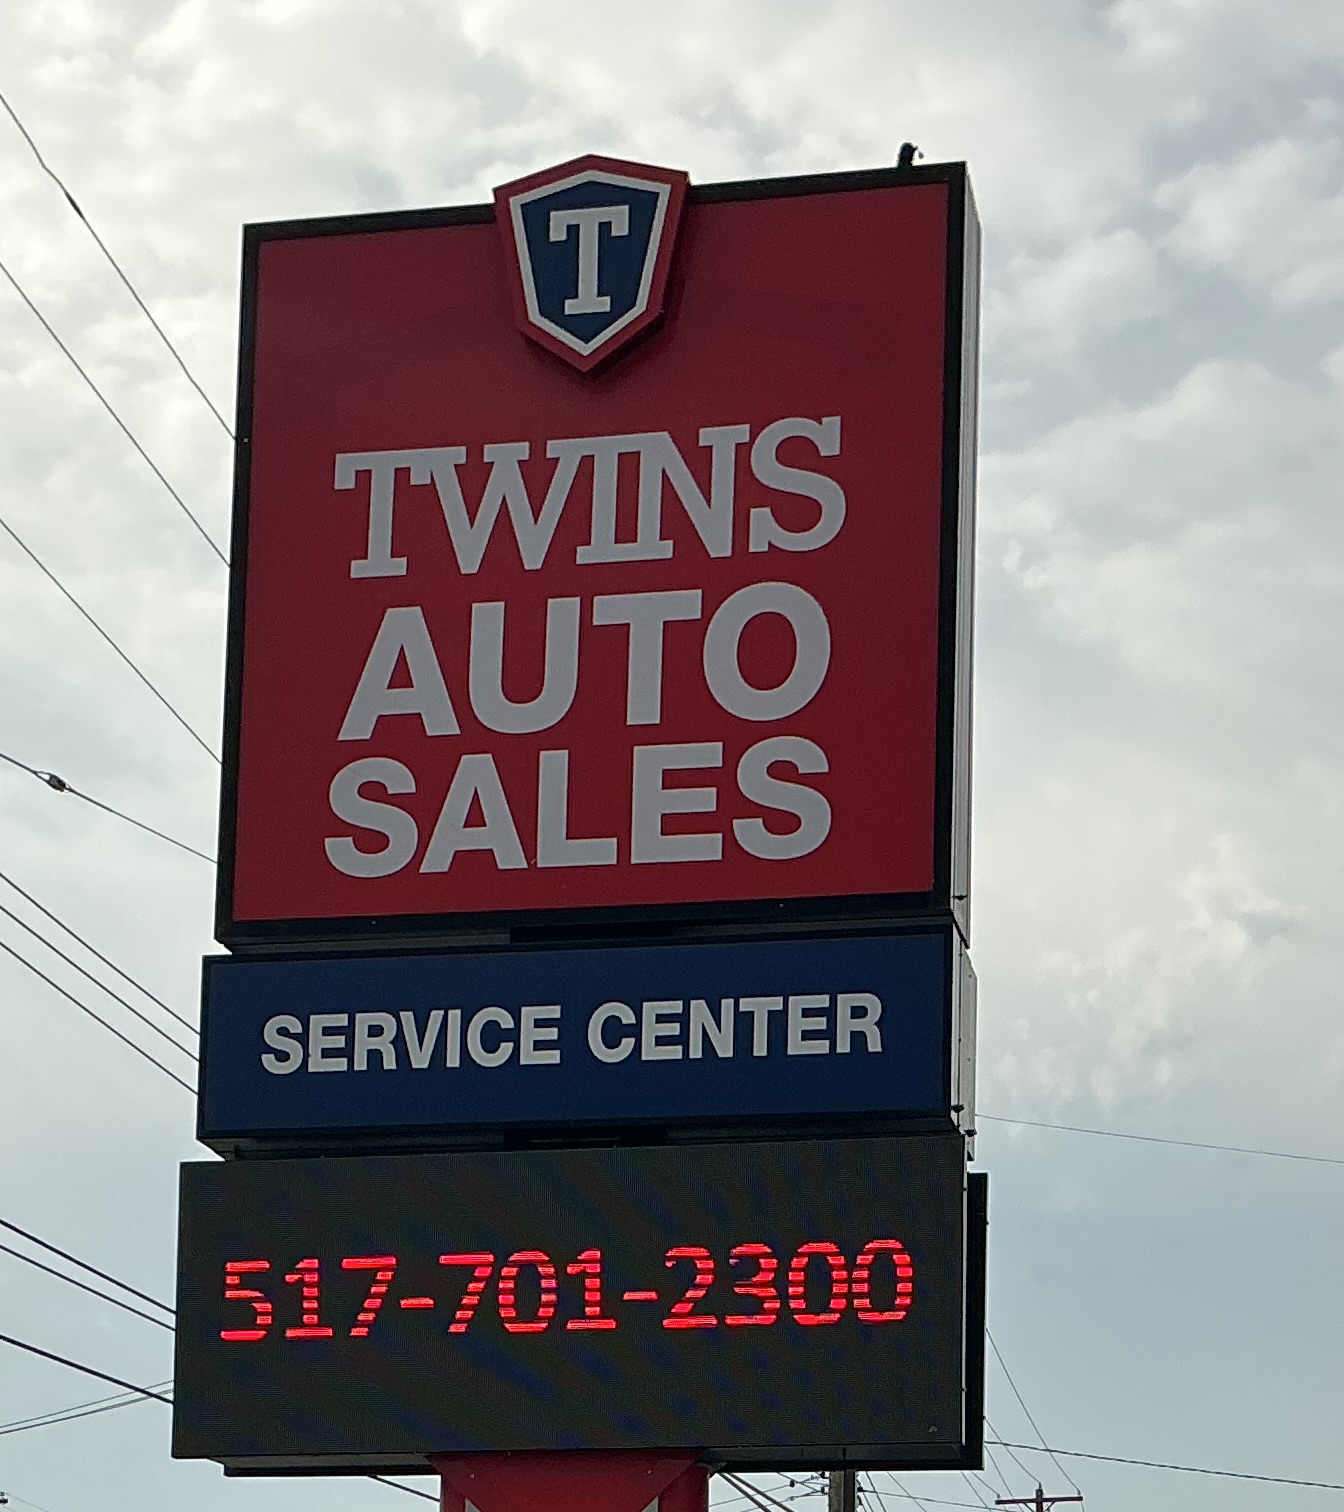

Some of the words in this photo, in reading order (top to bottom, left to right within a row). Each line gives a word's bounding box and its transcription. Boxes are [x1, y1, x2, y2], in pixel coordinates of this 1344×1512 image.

[549, 204, 630, 316] T
[333, 415, 847, 579] TWINS
[336, 580, 831, 742] AUTO
[323, 735, 833, 878] SALES
[260, 1004, 562, 1076] SERVICE
[586, 991, 883, 1064] CENTER
[219, 1239, 912, 1341] 517-701-2300
